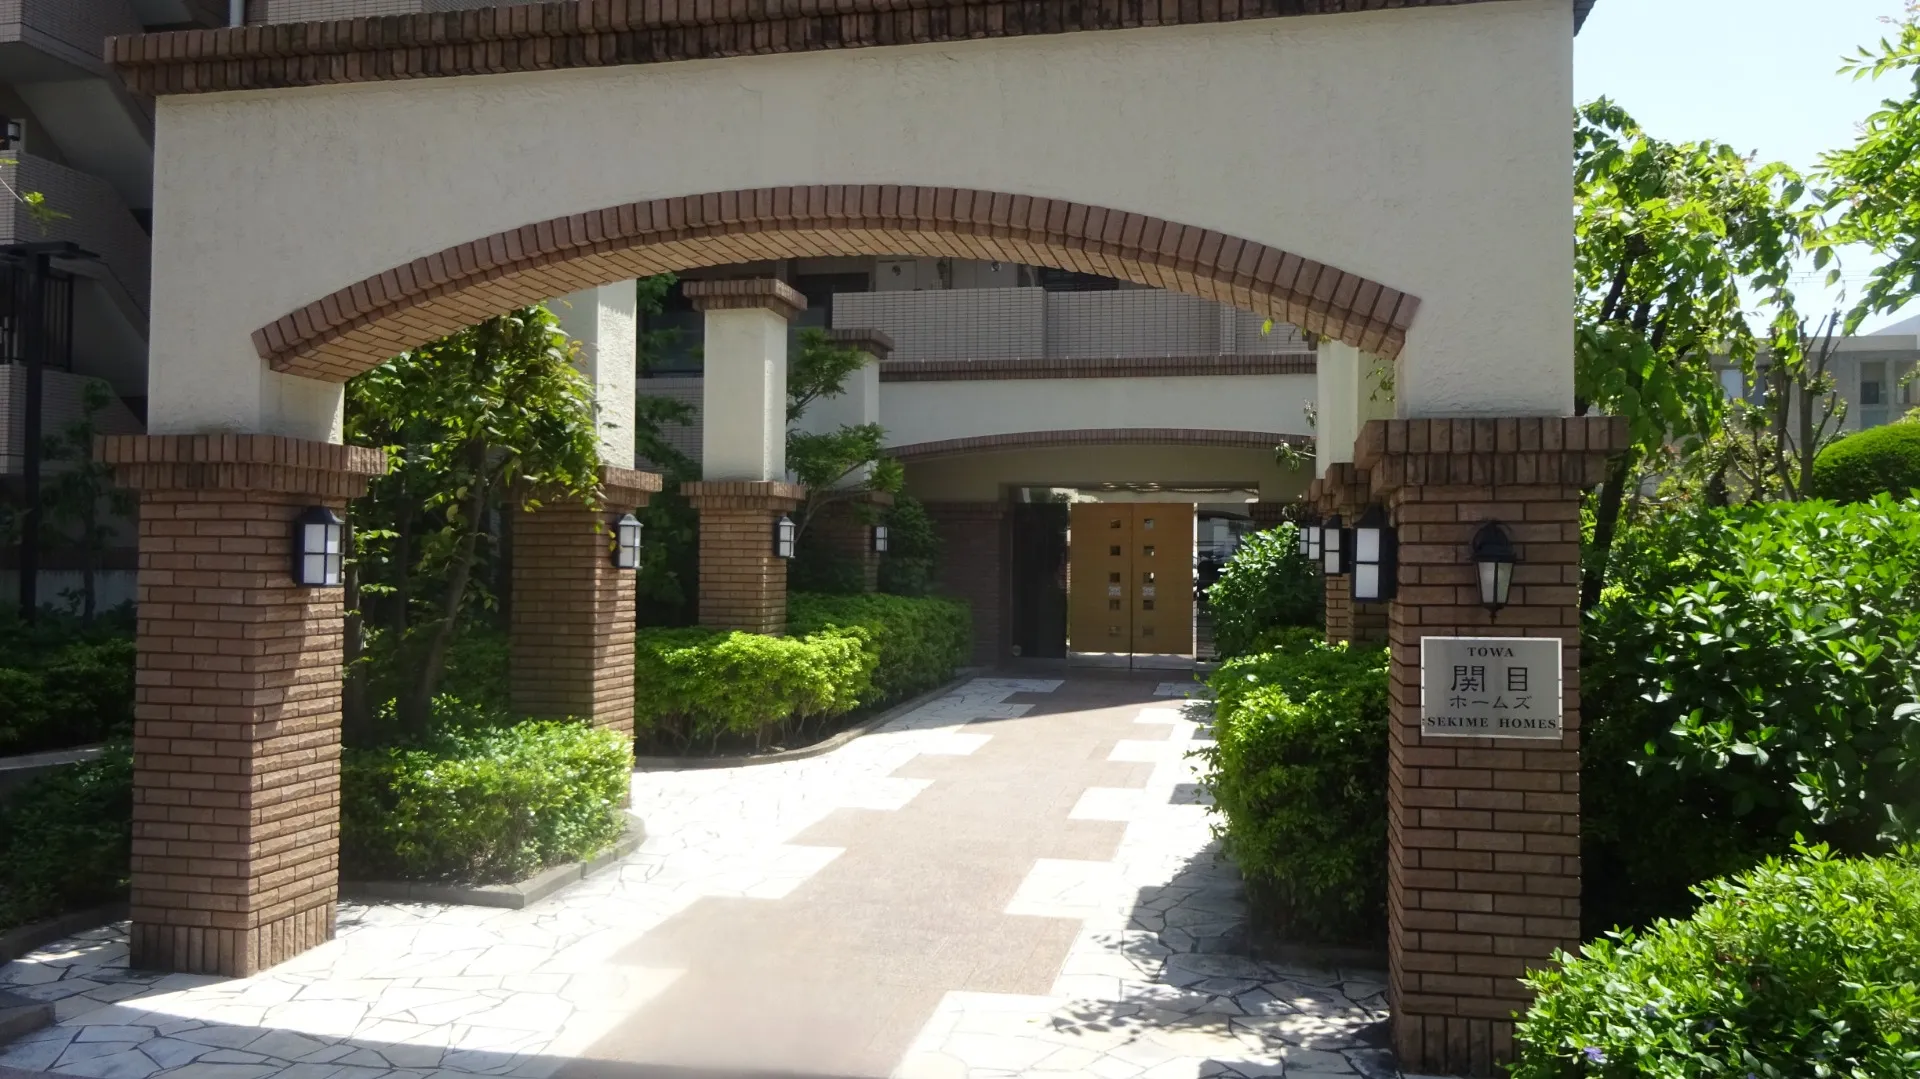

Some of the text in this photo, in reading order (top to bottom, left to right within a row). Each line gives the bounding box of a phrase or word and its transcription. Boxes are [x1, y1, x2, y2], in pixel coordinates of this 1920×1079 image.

[1467, 647, 1515, 657] TOWA
[1451, 665, 1528, 692] 関目
[1450, 695, 1532, 710] ホームズ
[1427, 716, 1557, 729] SEKIME HOMES
